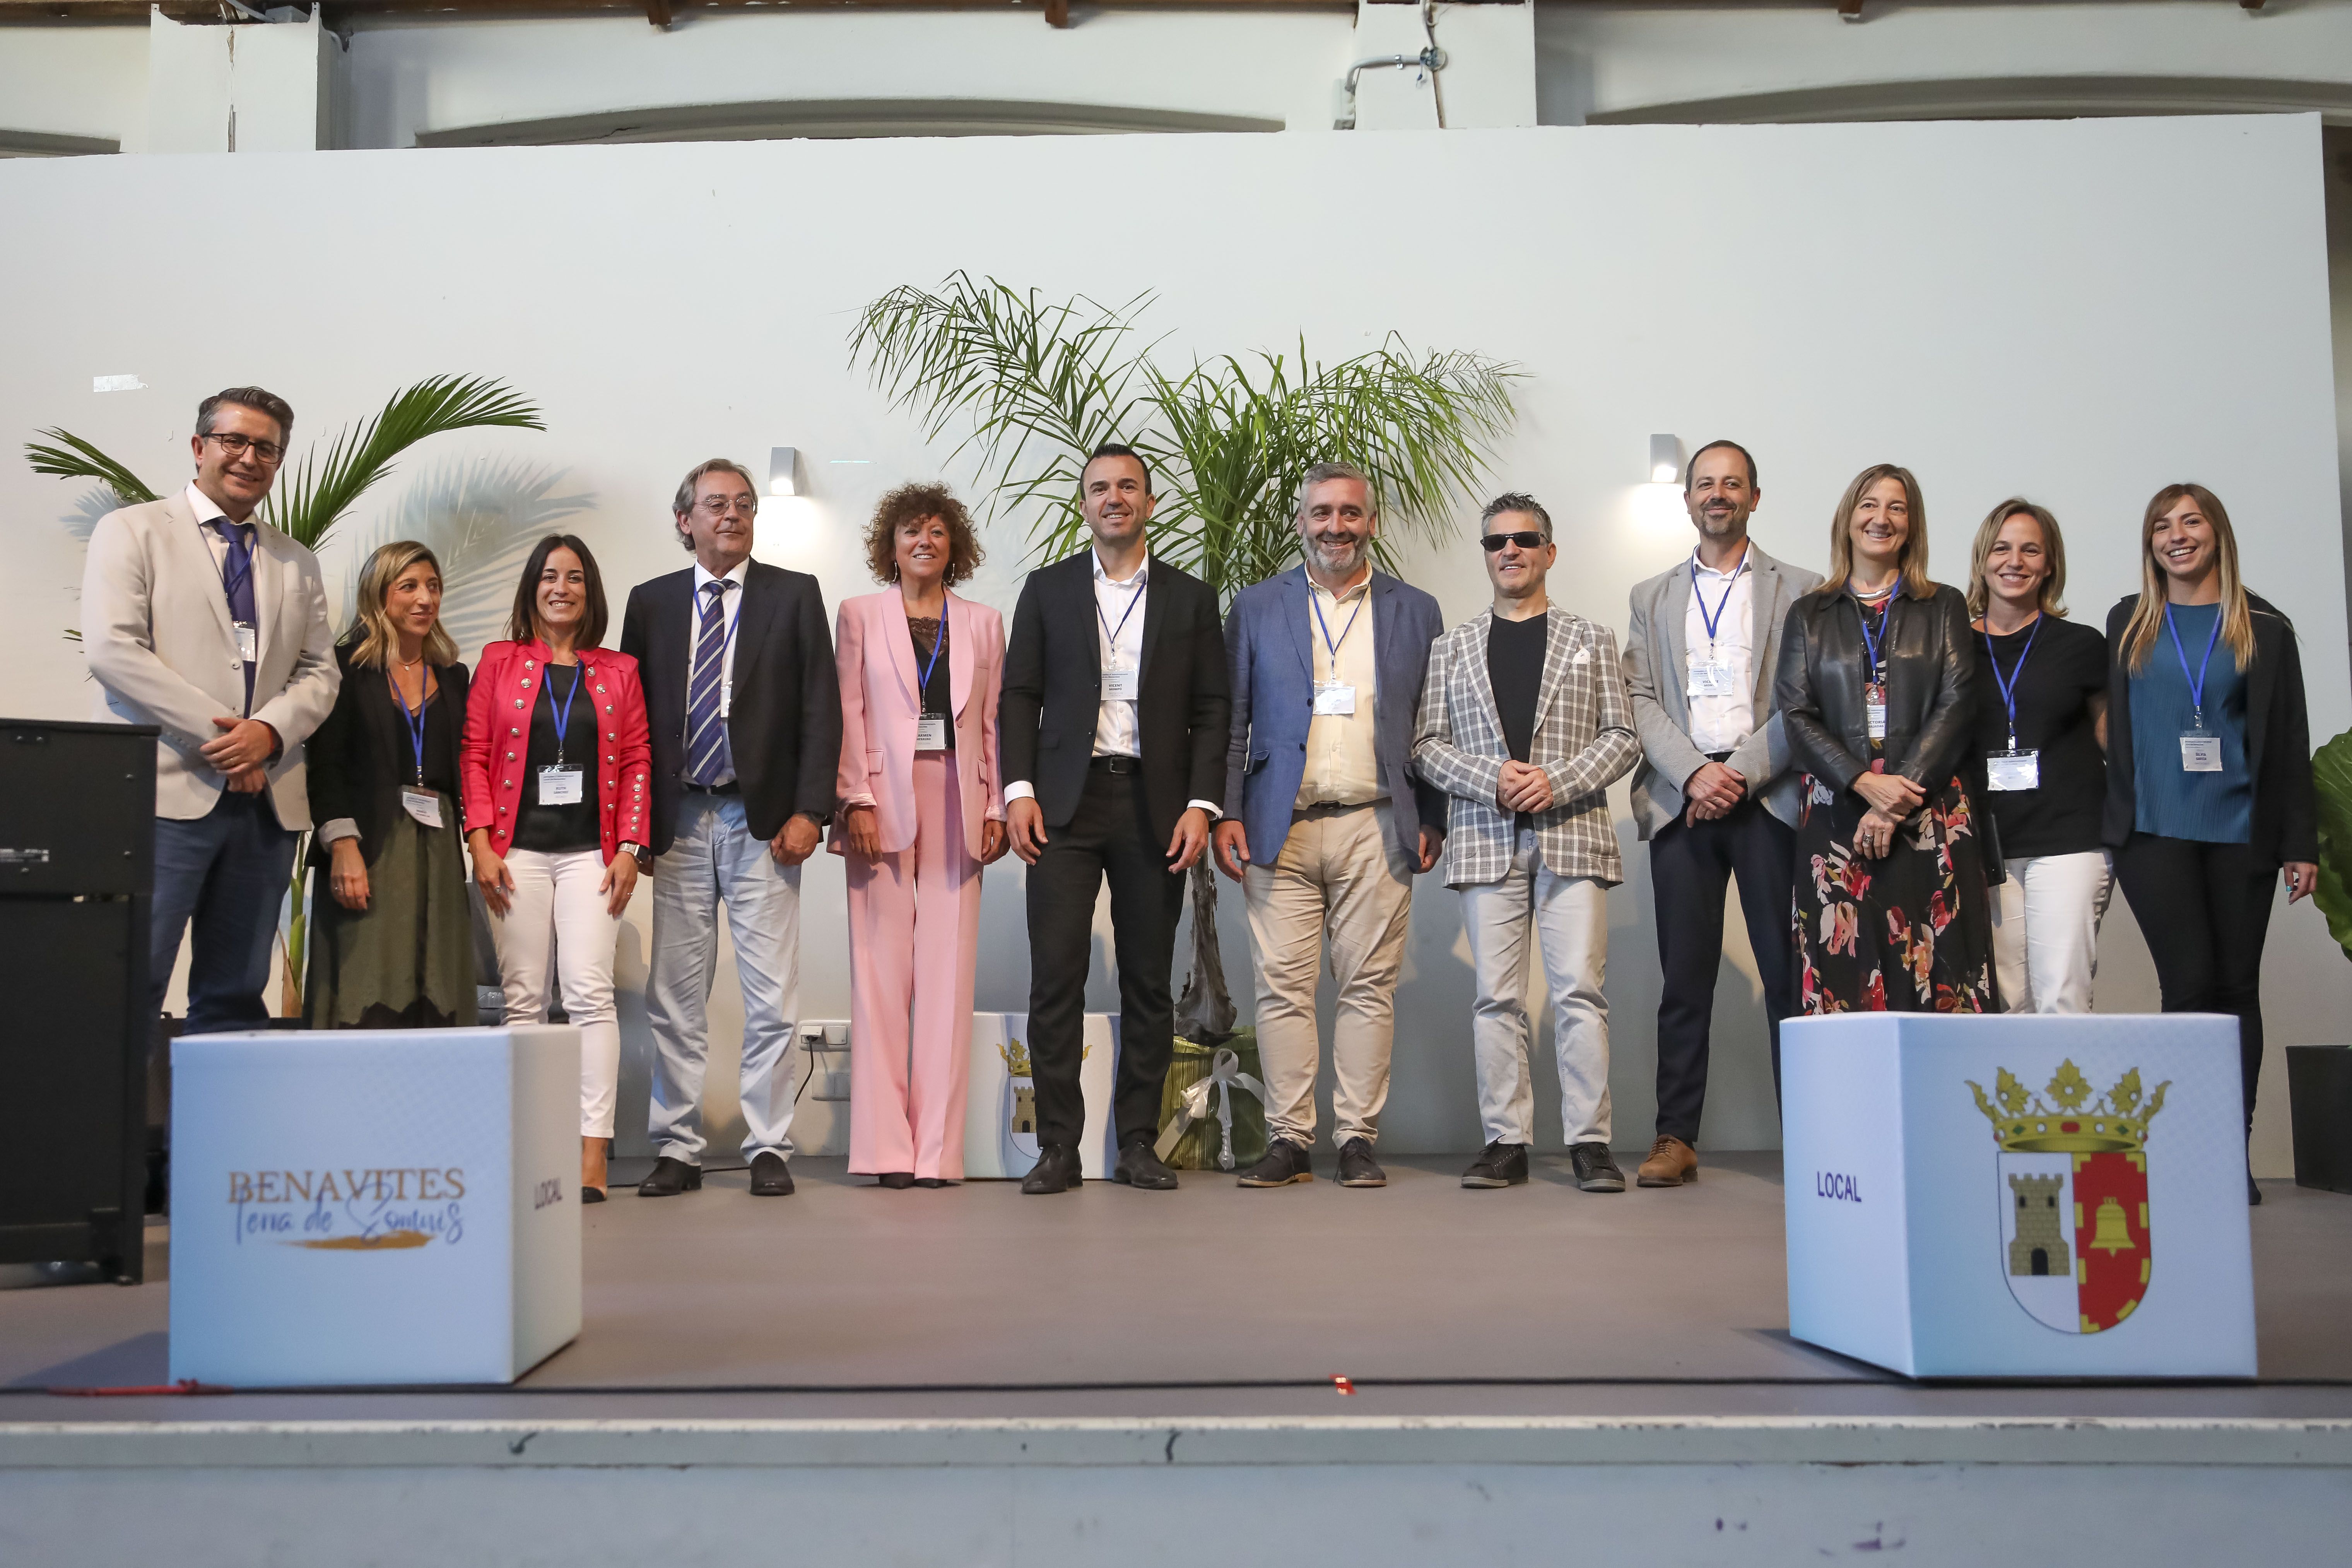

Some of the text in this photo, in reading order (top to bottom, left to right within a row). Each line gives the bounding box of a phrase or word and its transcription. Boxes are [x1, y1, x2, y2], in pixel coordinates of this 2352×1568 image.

[228, 1167, 466, 1204] BENAVITES
[534, 1179, 563, 1210] LOCAL
[1817, 1170, 1862, 1202] LOCAL
[303, 1187, 333, 1233] de
